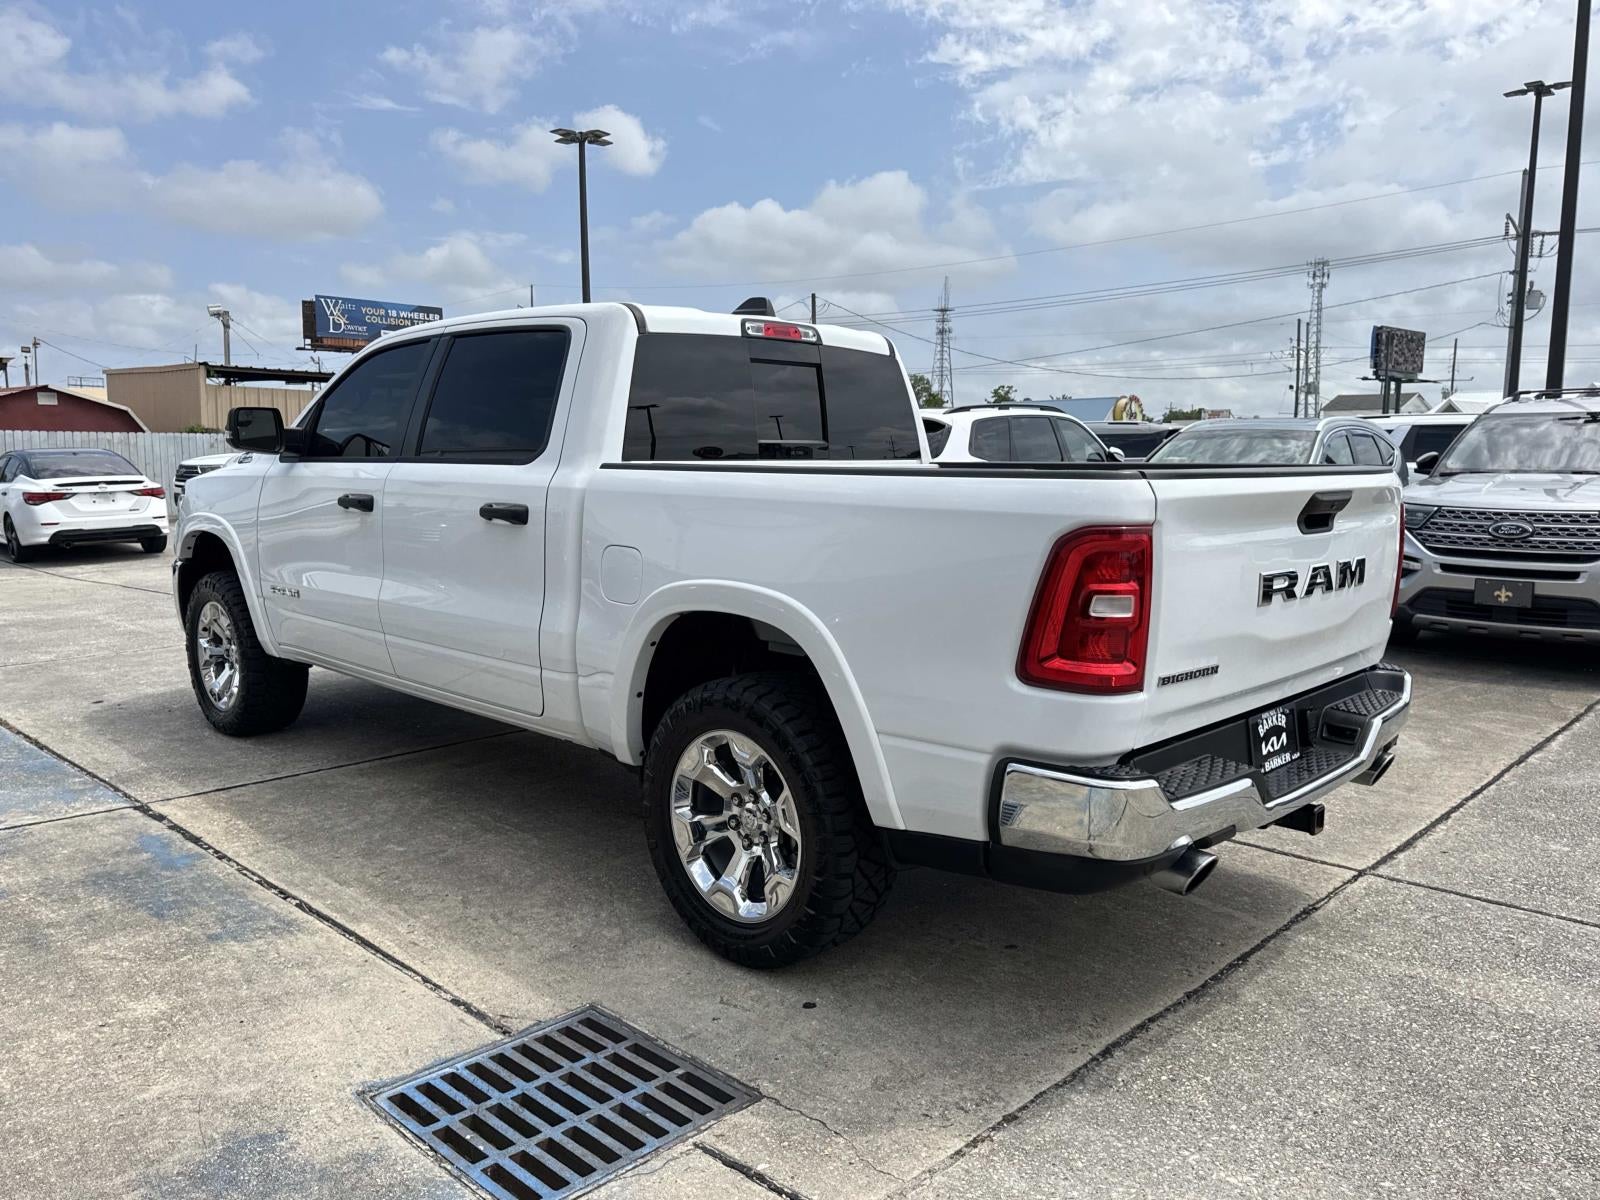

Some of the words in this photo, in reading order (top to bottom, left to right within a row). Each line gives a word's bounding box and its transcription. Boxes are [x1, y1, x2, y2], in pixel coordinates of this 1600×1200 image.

[319, 298, 356, 316] Waitz
[361, 306, 385, 316] YOUR
[399, 311, 440, 321] WHEELER
[328, 315, 367, 333] Downer
[365, 315, 411, 326] COLLISION
[1257, 555, 1366, 607] RAM
[1157, 664, 1219, 687] BIGHORN
[1258, 713, 1287, 738] BARKER
[1264, 752, 1291, 772] BARKER
